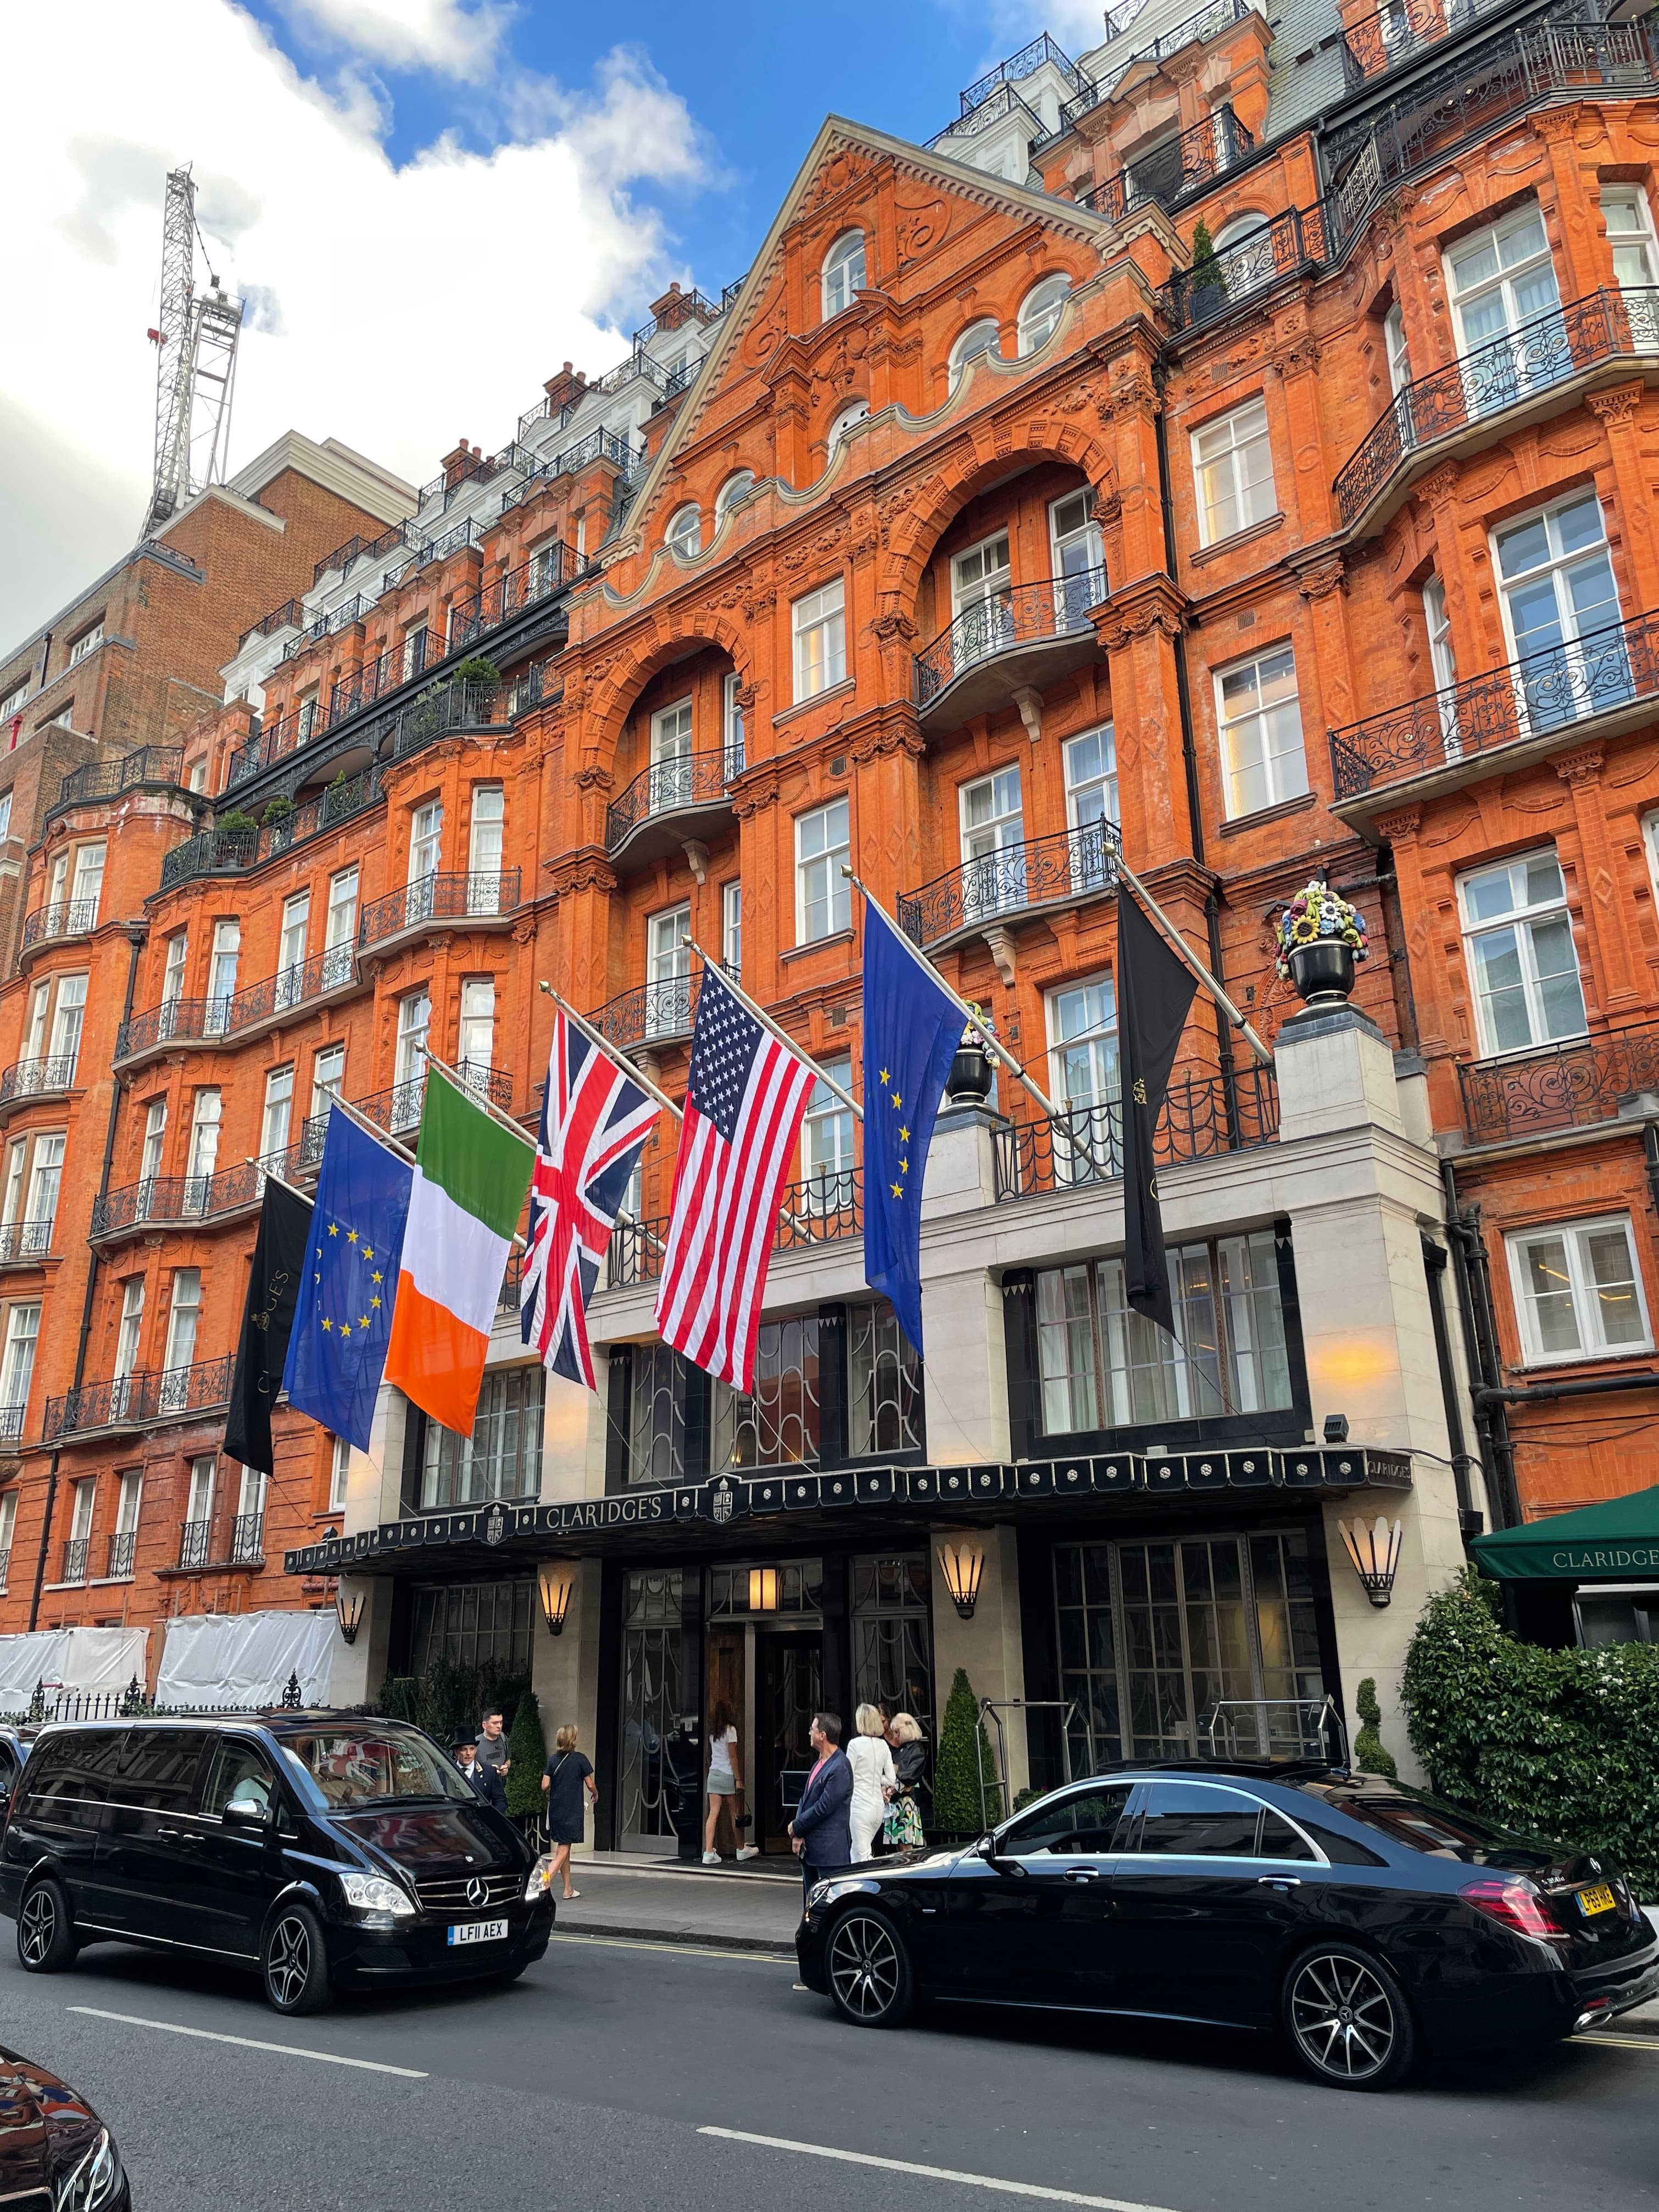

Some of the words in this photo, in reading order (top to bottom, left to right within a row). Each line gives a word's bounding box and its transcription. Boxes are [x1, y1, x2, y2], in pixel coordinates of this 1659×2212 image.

[546, 1496, 662, 1529] CLARIDGE'S
[460, 1925, 480, 1941] LF11
[483, 1922, 502, 1938] AEX
